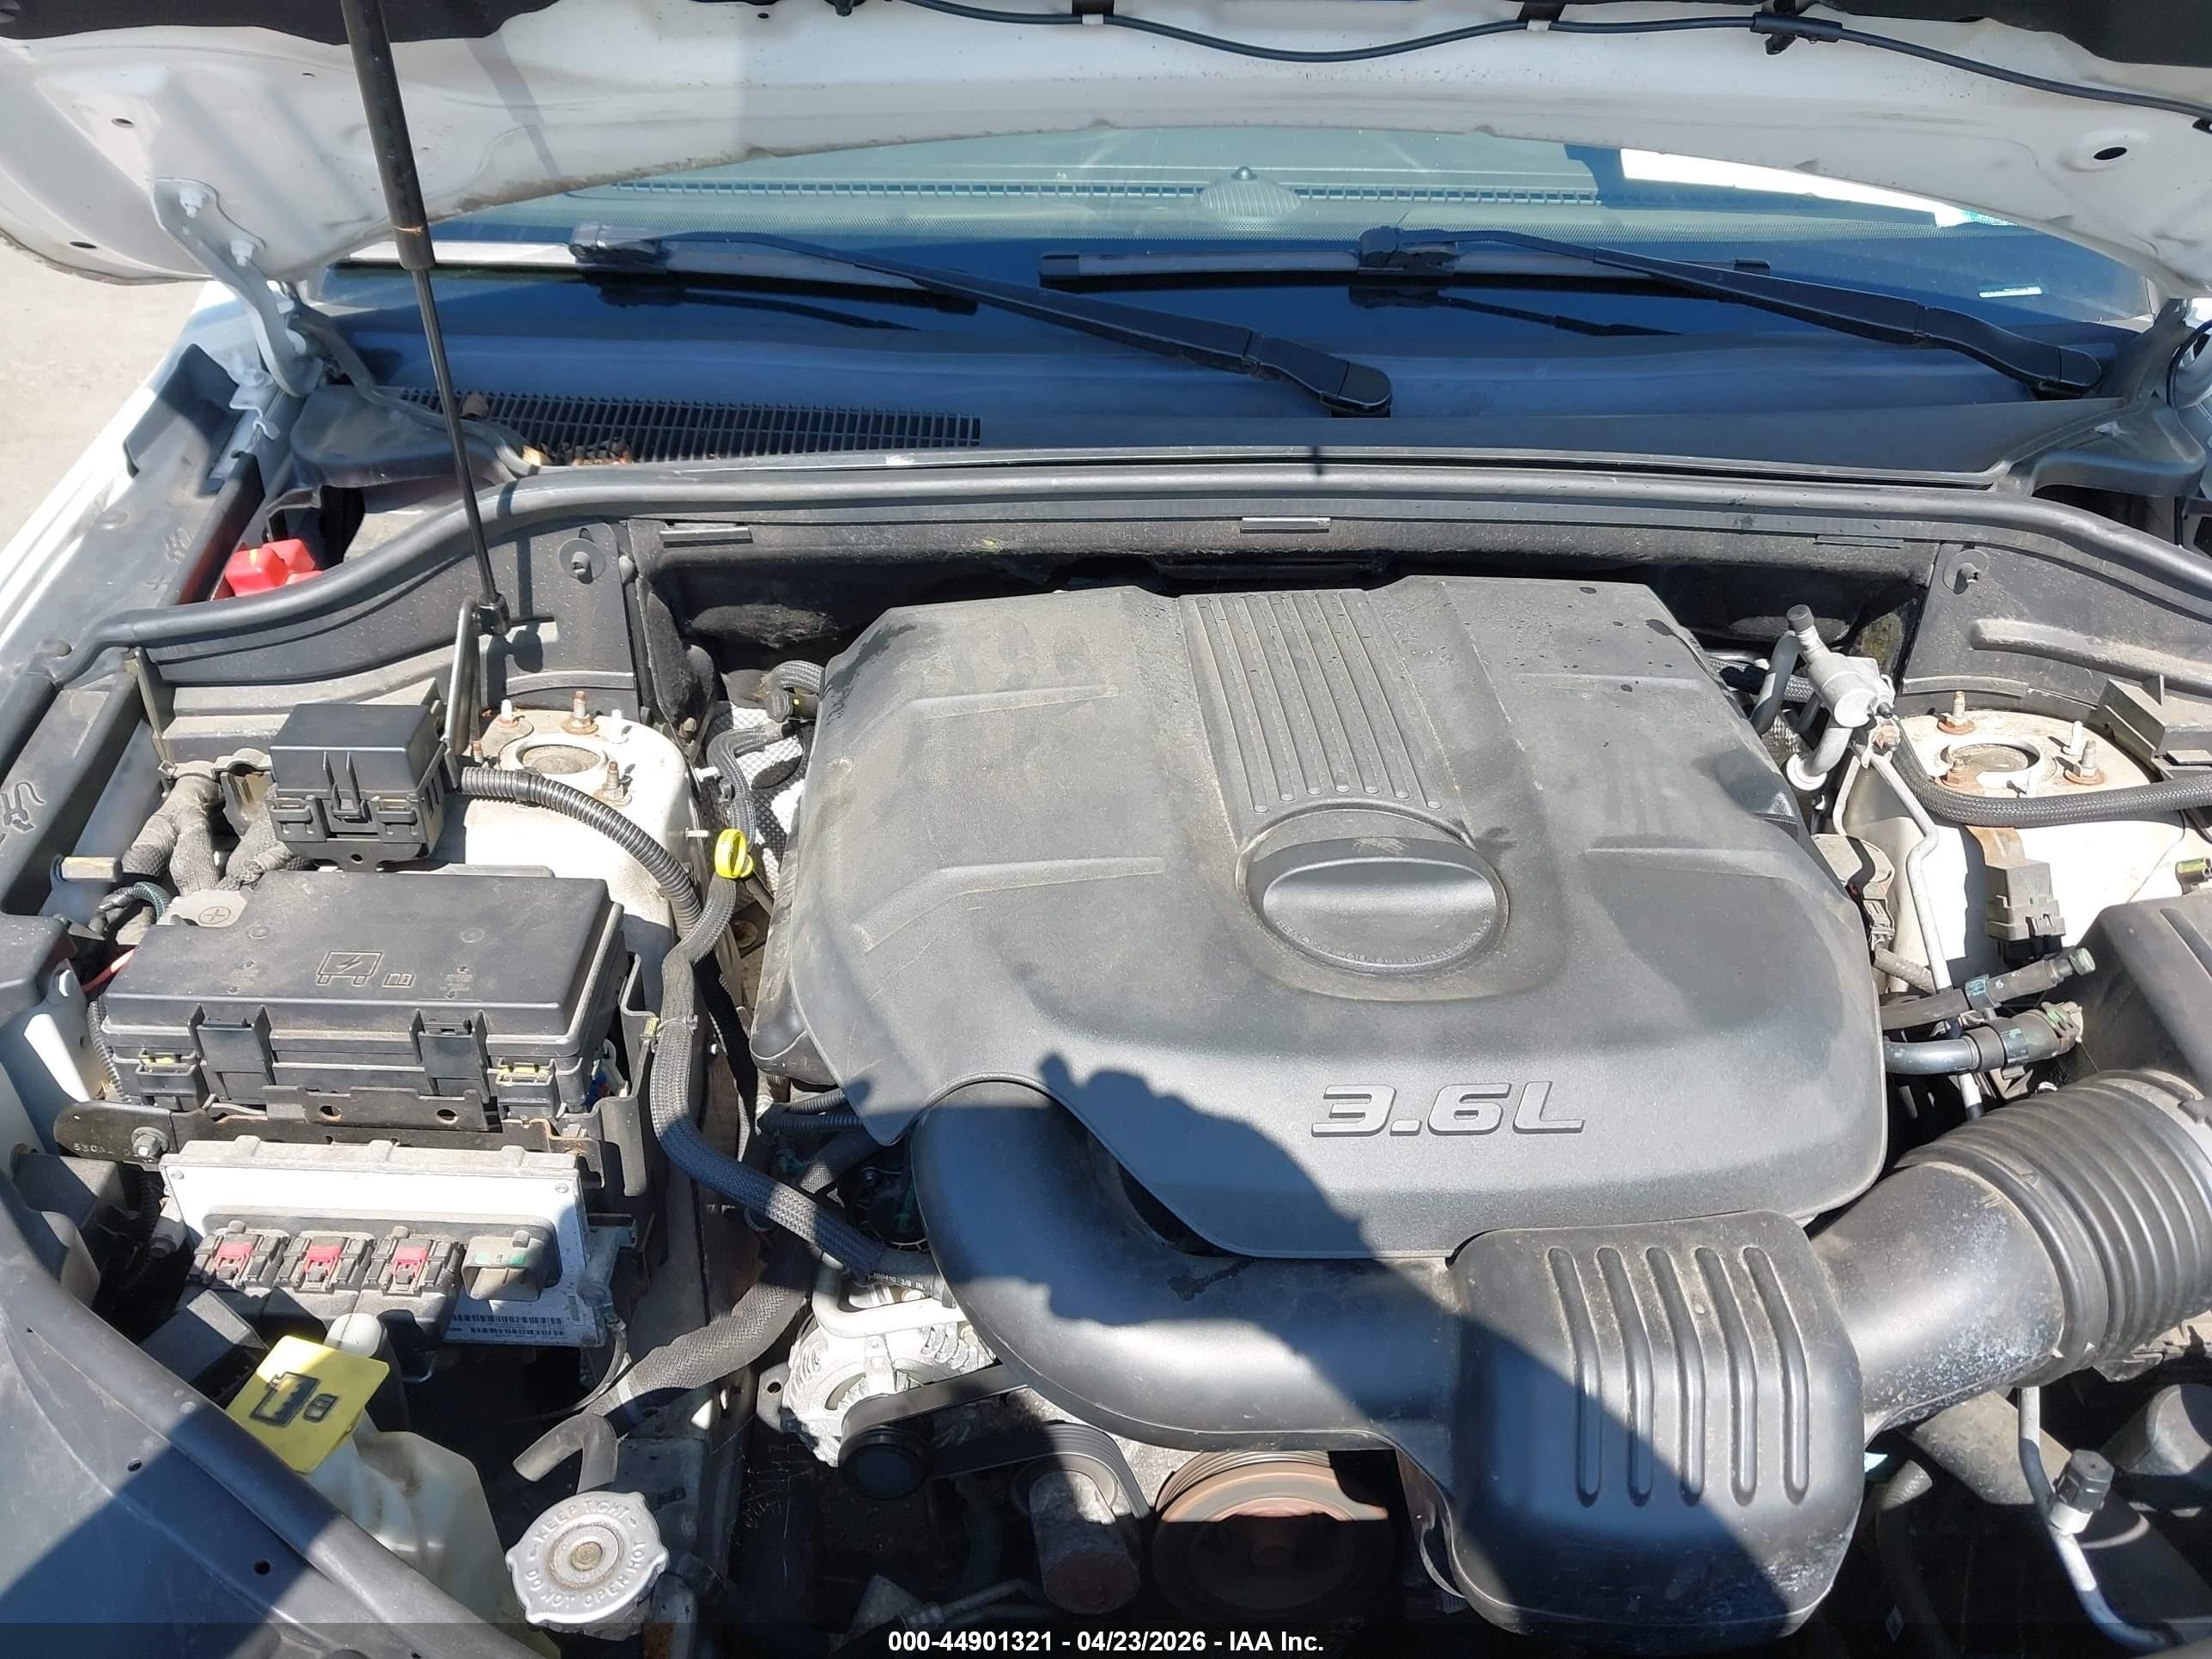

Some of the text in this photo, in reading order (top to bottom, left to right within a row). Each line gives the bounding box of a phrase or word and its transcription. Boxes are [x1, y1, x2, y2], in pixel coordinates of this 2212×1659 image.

[1310, 1080, 1586, 1138] 3.6L
[533, 1498, 630, 1543] KEEP TIGHT
[583, 1575, 630, 1608] OPEN
[625, 1541, 647, 1573] HOT
